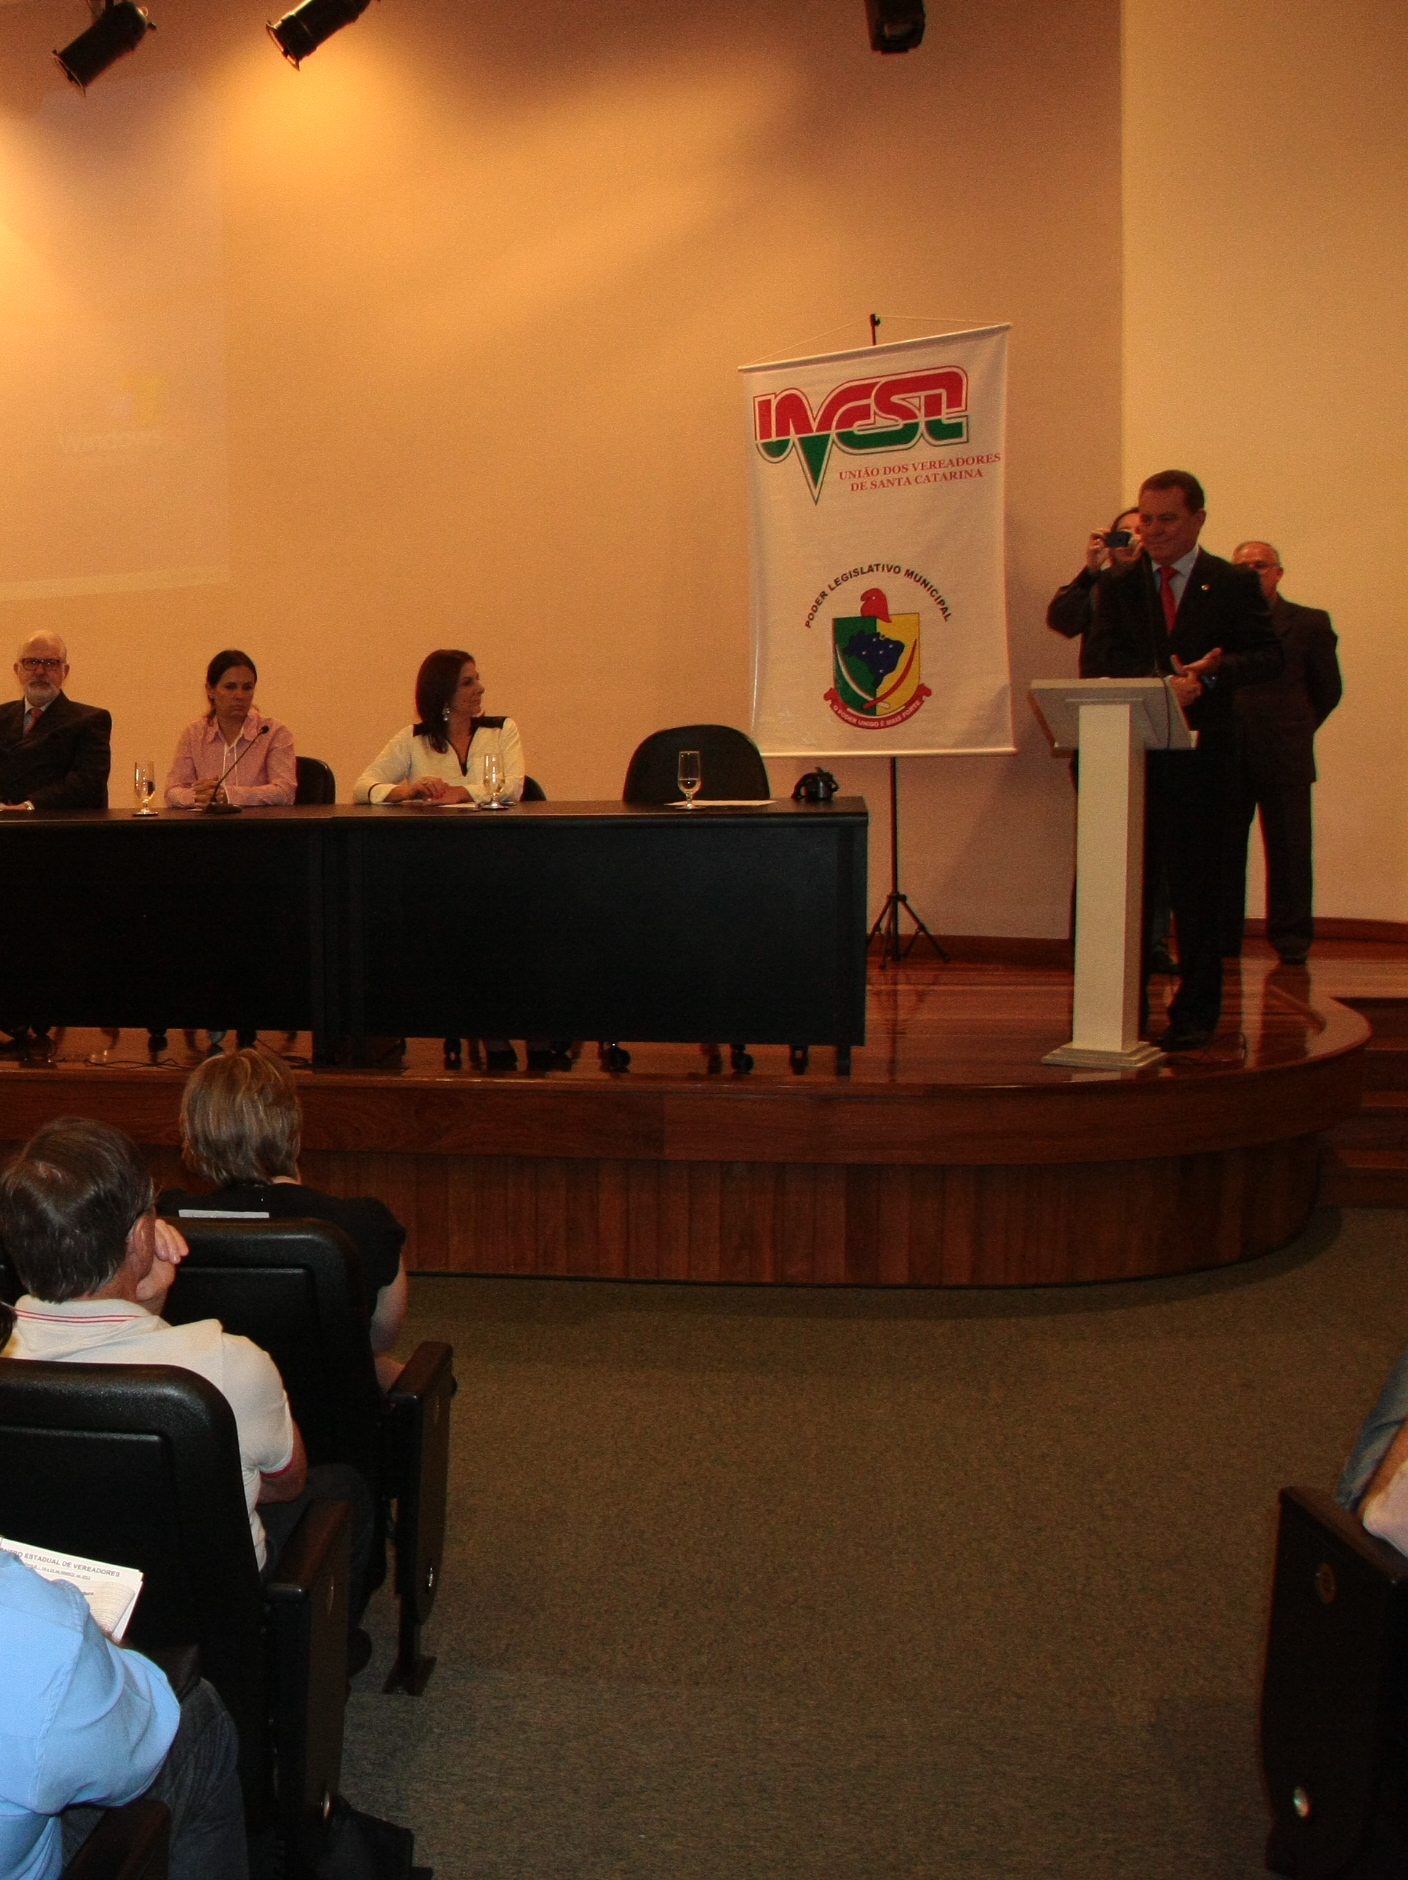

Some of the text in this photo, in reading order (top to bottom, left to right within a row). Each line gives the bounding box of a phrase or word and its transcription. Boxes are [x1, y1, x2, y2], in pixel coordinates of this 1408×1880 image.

[839, 452, 1001, 480] UNIÃO DOS VEREADORES
[850, 468, 984, 491] DE SANTA CATARINA
[805, 563, 952, 628] PODER LEGISLATIVO MUNICIPAL
[837, 709, 857, 724] PODER
[24, 1552, 61, 1566] ESTADUAL
[62, 1560, 72, 1568] DE
[73, 1562, 121, 1578] VEREADORES
